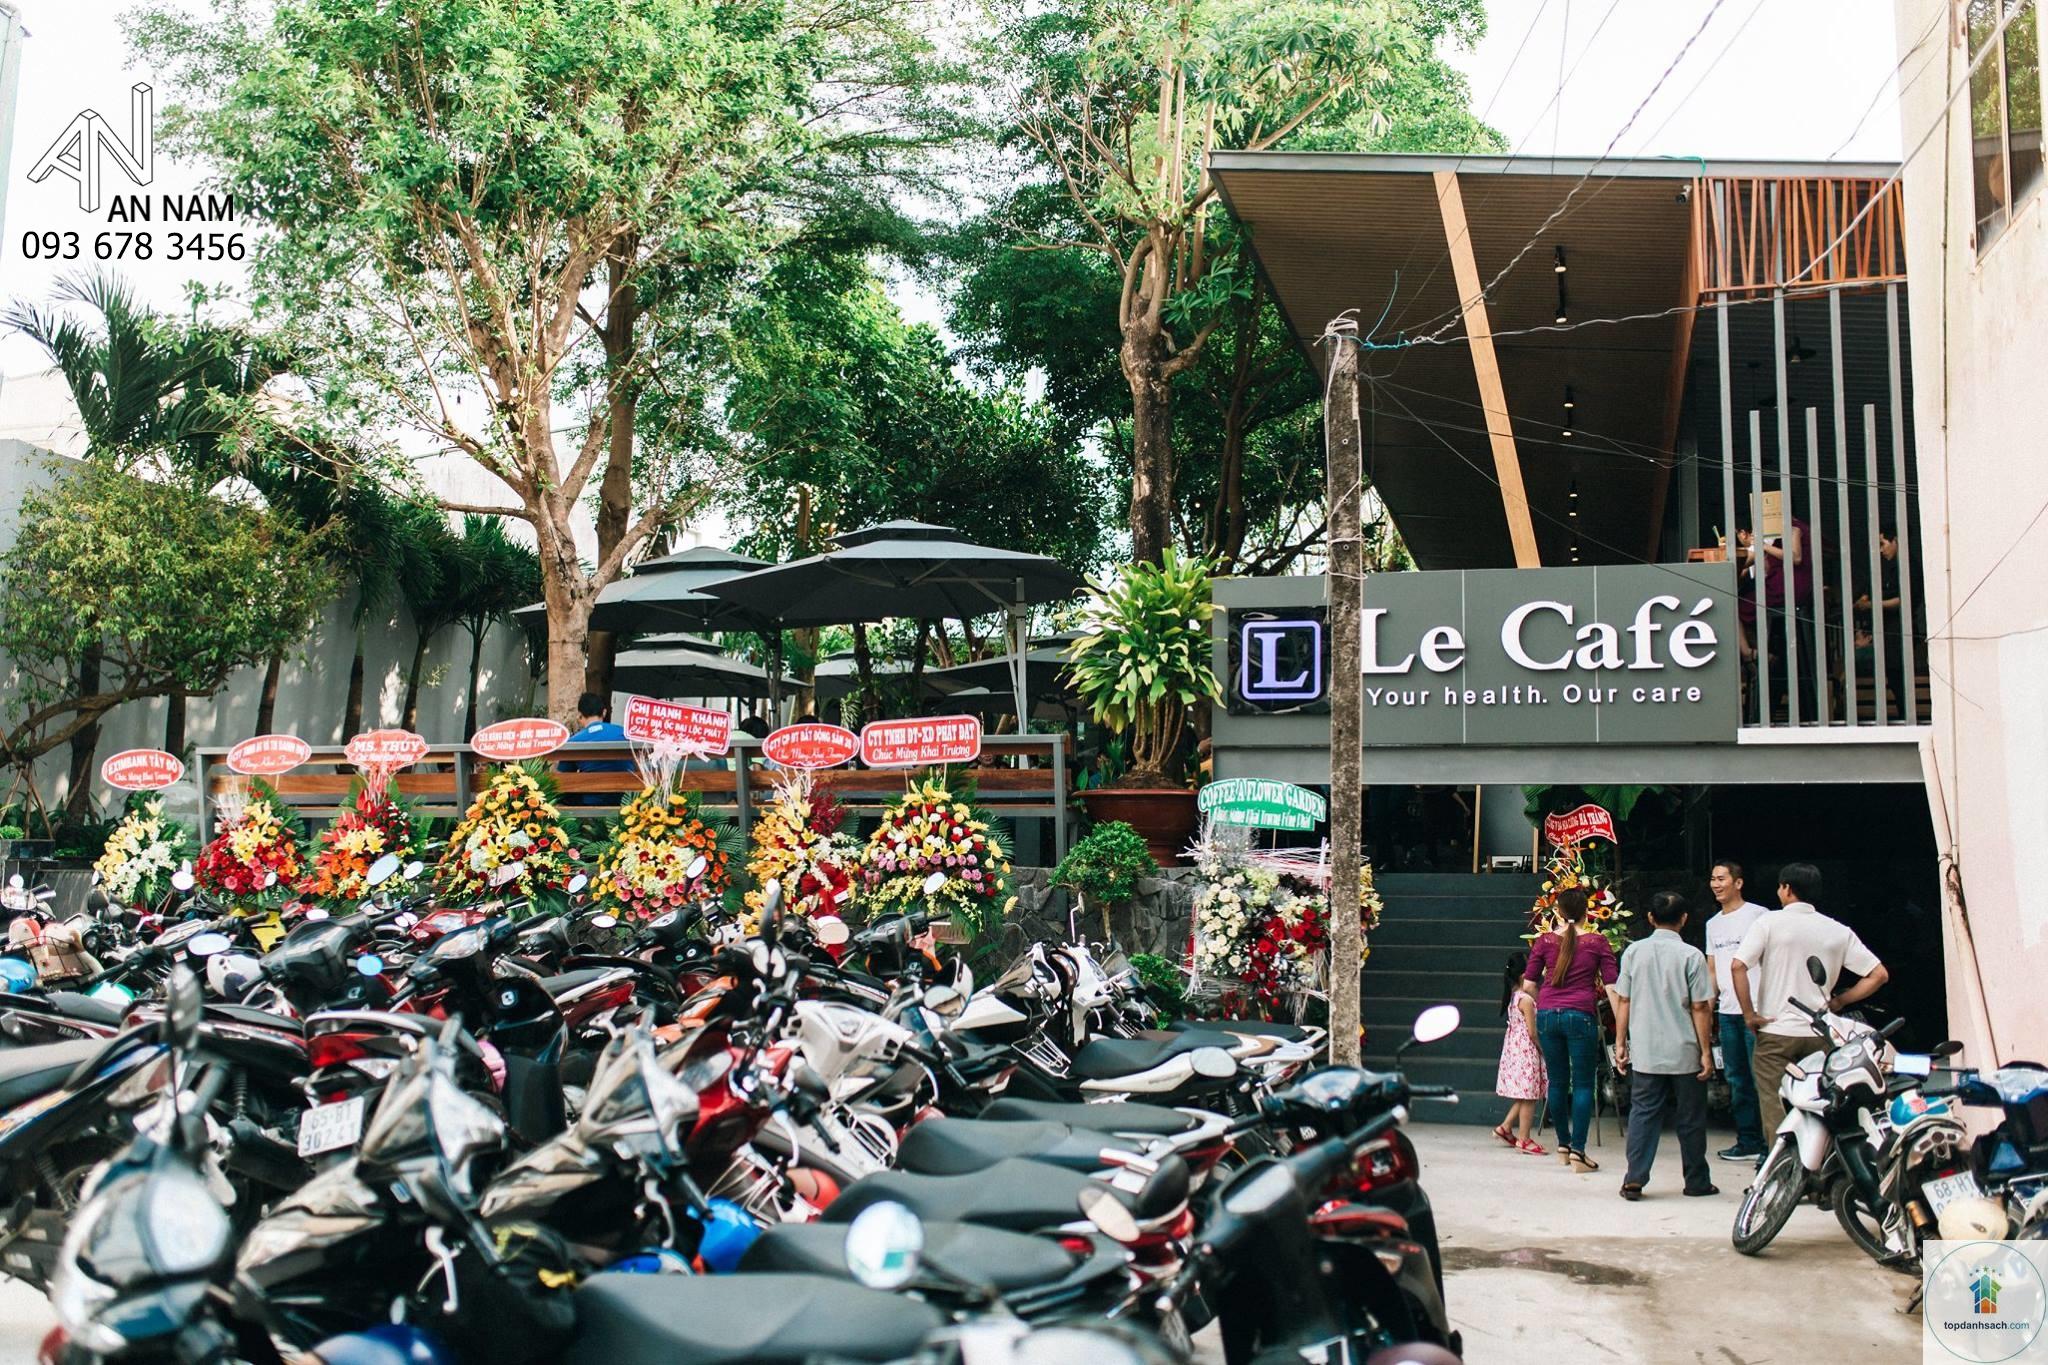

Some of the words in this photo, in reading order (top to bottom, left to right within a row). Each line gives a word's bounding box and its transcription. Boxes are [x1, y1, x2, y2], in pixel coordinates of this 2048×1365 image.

[1362, 607, 1466, 675] Le
[1501, 595, 1718, 671] Café
[1366, 687, 1431, 706] Your
[1444, 684, 1548, 705] health.
[1563, 683, 1618, 704] Our
[1632, 685, 1703, 703] care
[1201, 782, 1236, 809] COFFEE
[1245, 781, 1284, 805] FLOWER
[1286, 787, 1326, 819] GARDEN
